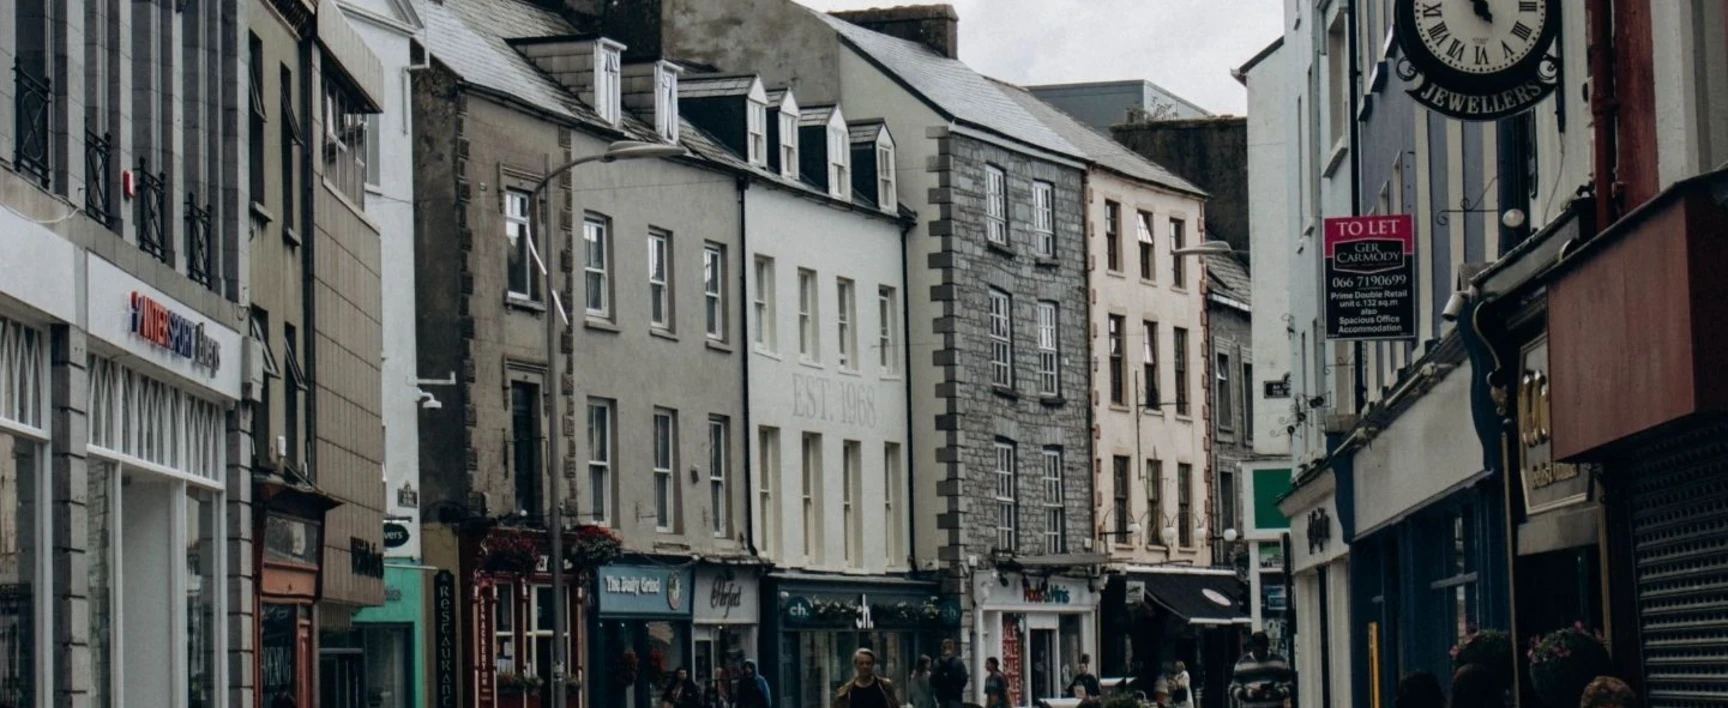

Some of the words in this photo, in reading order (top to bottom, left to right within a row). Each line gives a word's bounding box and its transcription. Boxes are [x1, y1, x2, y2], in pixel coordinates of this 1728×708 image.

[1420, 81, 1542, 114] JEWELLERS
[1336, 221, 1363, 236] TO
[1368, 219, 1400, 235] LET
[1355, 242, 1381, 253] GER
[1337, 251, 1400, 263] CARMODY
[1332, 277, 1354, 288] 066
[1357, 274, 1407, 287] 7190699
[1330, 291, 1353, 300] Prime
[1354, 289, 1383, 299] Double
[1384, 289, 1408, 298] Retail
[1340, 299, 1355, 308] unit
[1361, 307, 1378, 315] also
[143, 295, 195, 359] INTERSPORT
[1339, 317, 1375, 327] Spacious
[1376, 314, 1400, 324] Office
[1338, 324, 1402, 334] Accommodation
[792, 373, 834, 420] EST.
[840, 381, 877, 428] 1968
[606, 575, 620, 593] The
[621, 575, 640, 597] Daily
[640, 576, 660, 593] Grind
